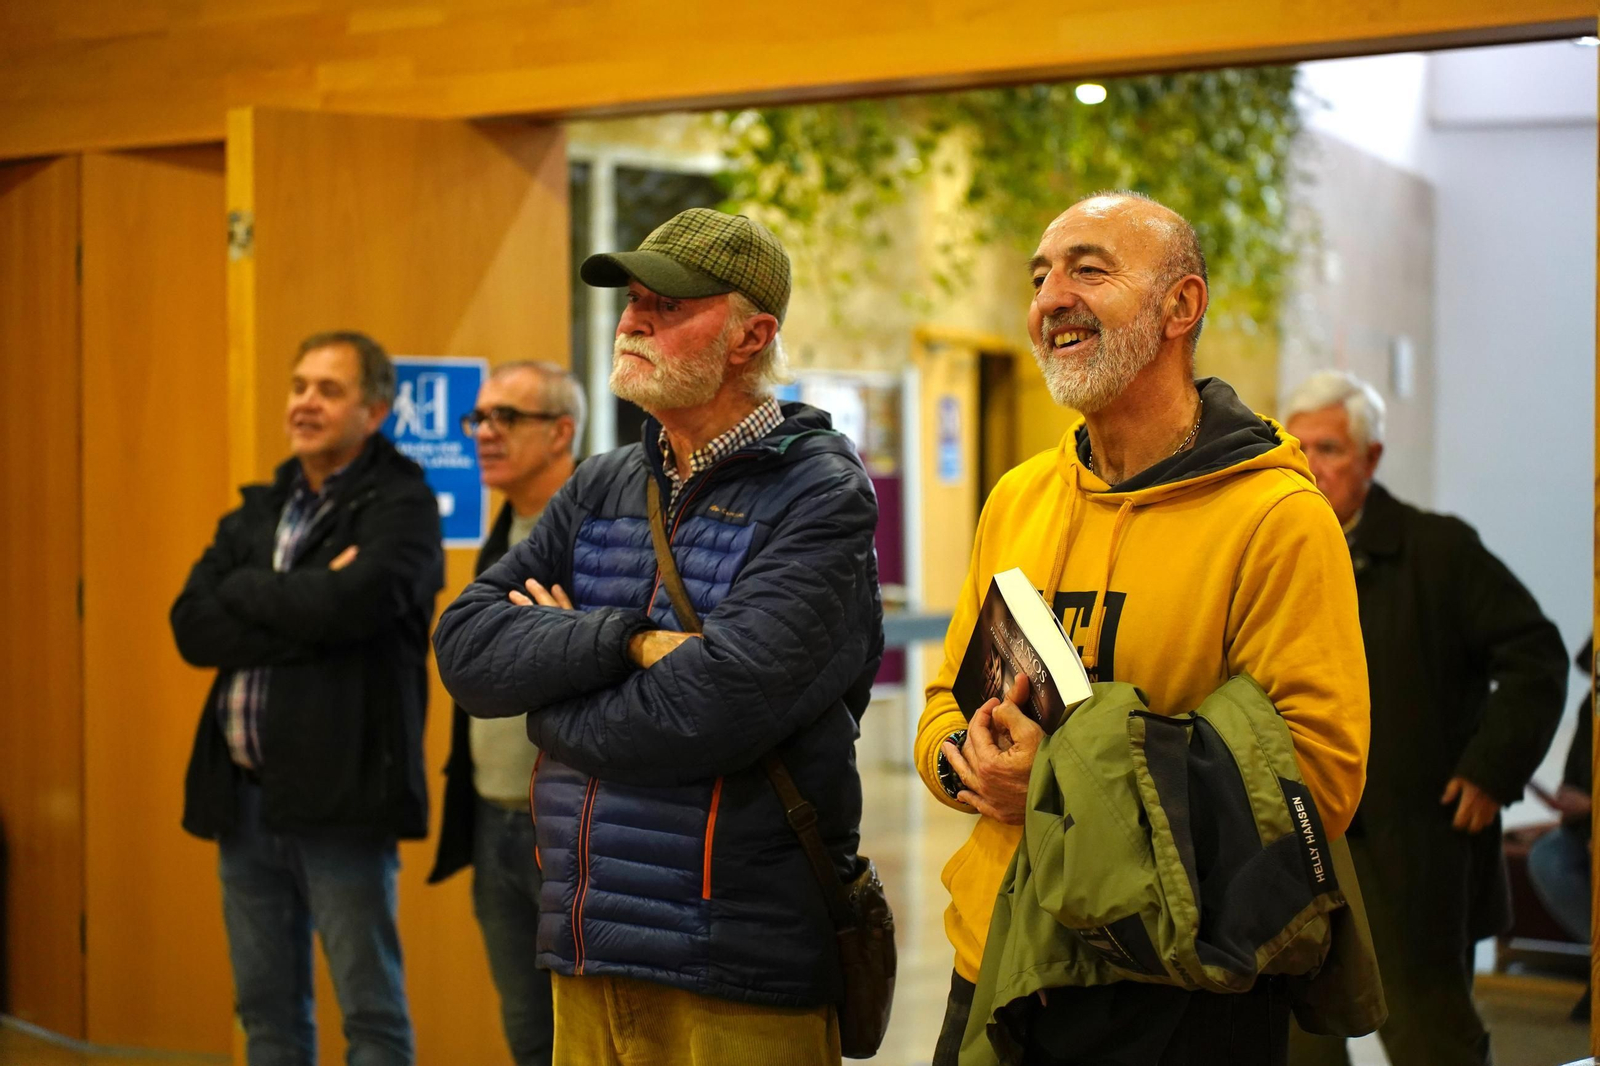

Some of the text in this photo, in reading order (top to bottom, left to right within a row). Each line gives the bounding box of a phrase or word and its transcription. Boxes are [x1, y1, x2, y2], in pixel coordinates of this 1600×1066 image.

[1017, 638, 1048, 683] AÑOS
[1292, 796, 1326, 883] HELLY HANSEN
